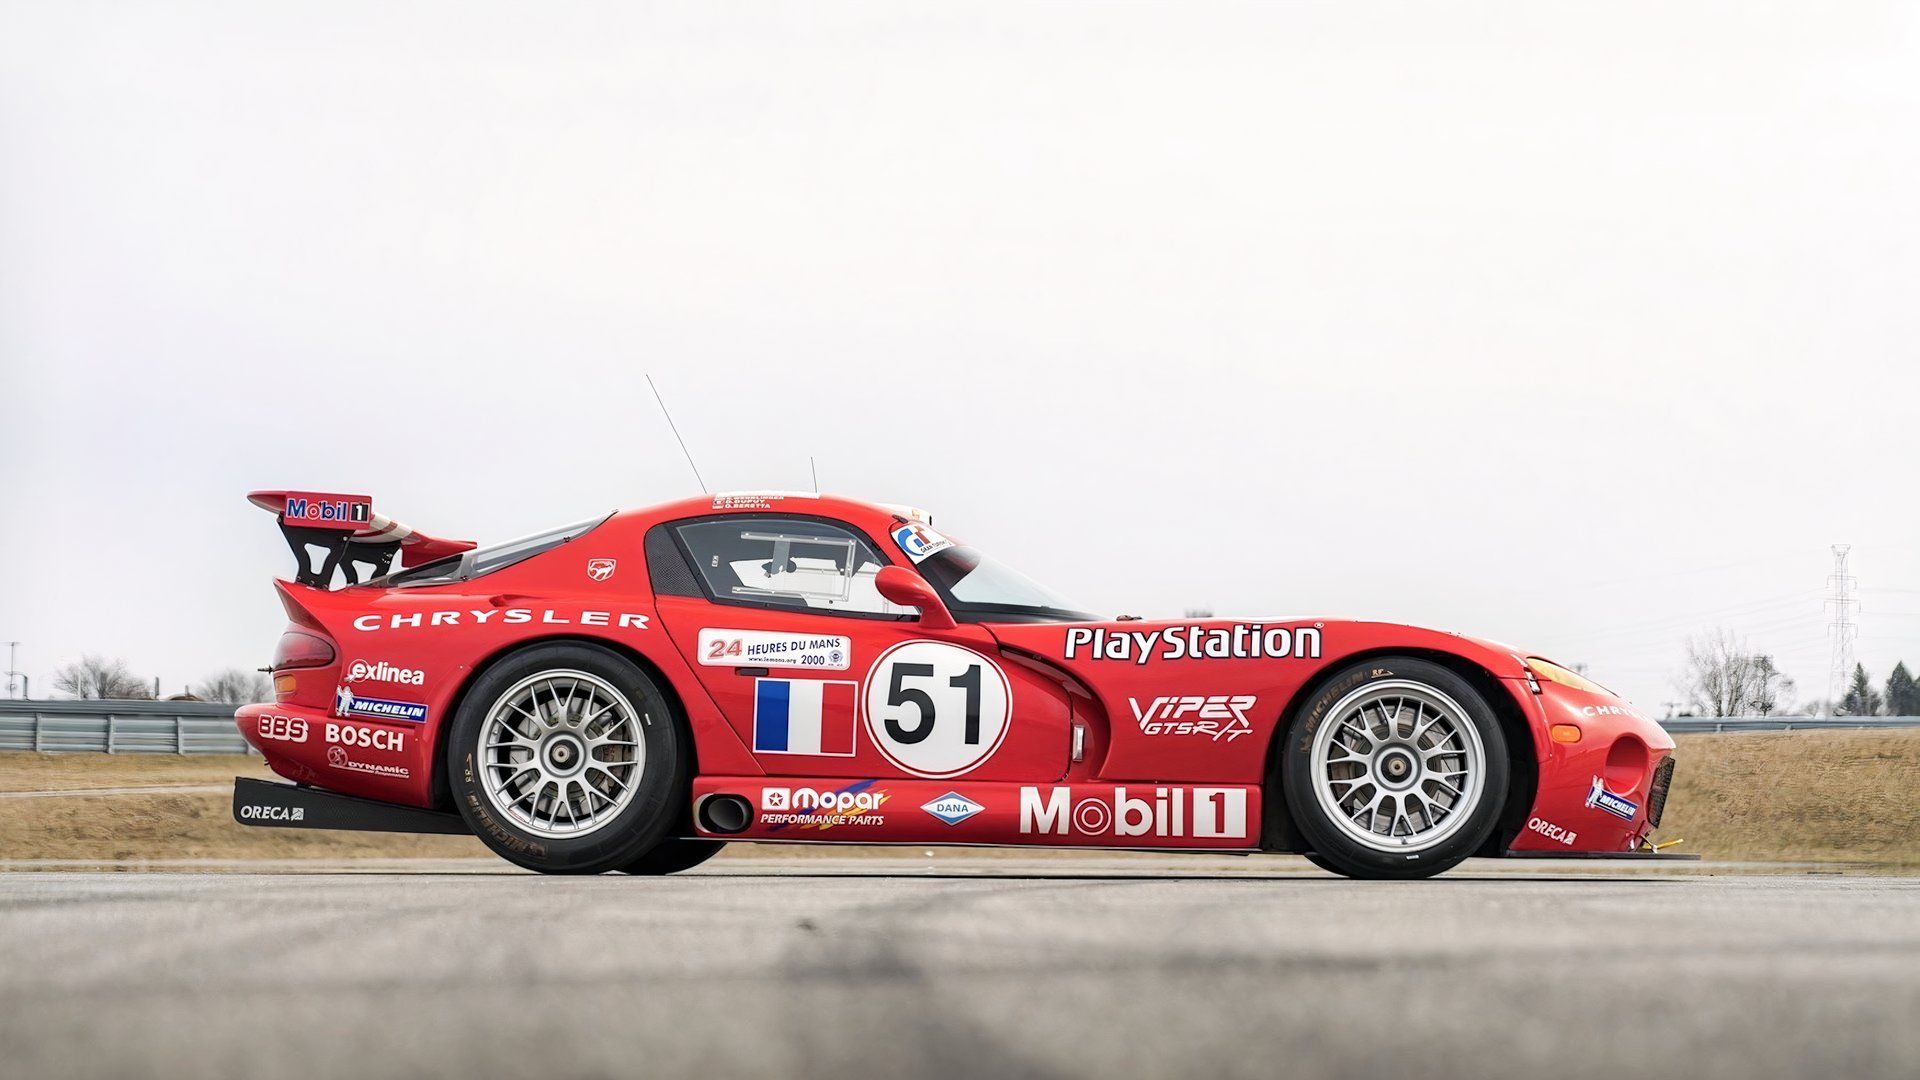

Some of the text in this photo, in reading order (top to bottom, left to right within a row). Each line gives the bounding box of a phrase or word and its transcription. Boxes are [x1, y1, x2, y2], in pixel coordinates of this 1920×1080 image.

[285, 498, 367, 521] Mobil 1
[353, 609, 650, 631] CHRYSLER
[708, 638, 841, 660] 24 HEURES DU MANS
[1065, 624, 1322, 665] PlayStation
[801, 655, 825, 665] 2000
[352, 661, 425, 685] exlinea
[353, 701, 424, 717] MICHELIN
[884, 662, 981, 745] 51
[258, 714, 309, 743] BBS
[325, 723, 404, 752] BOSCH
[792, 787, 885, 812] Mopar
[936, 803, 969, 813] DANA
[240, 805, 290, 820] ORECA
[760, 813, 884, 826] PERFORMANCE PARTS
[1019, 786, 1184, 837] Mobil
[1528, 817, 1567, 843] ORECA
